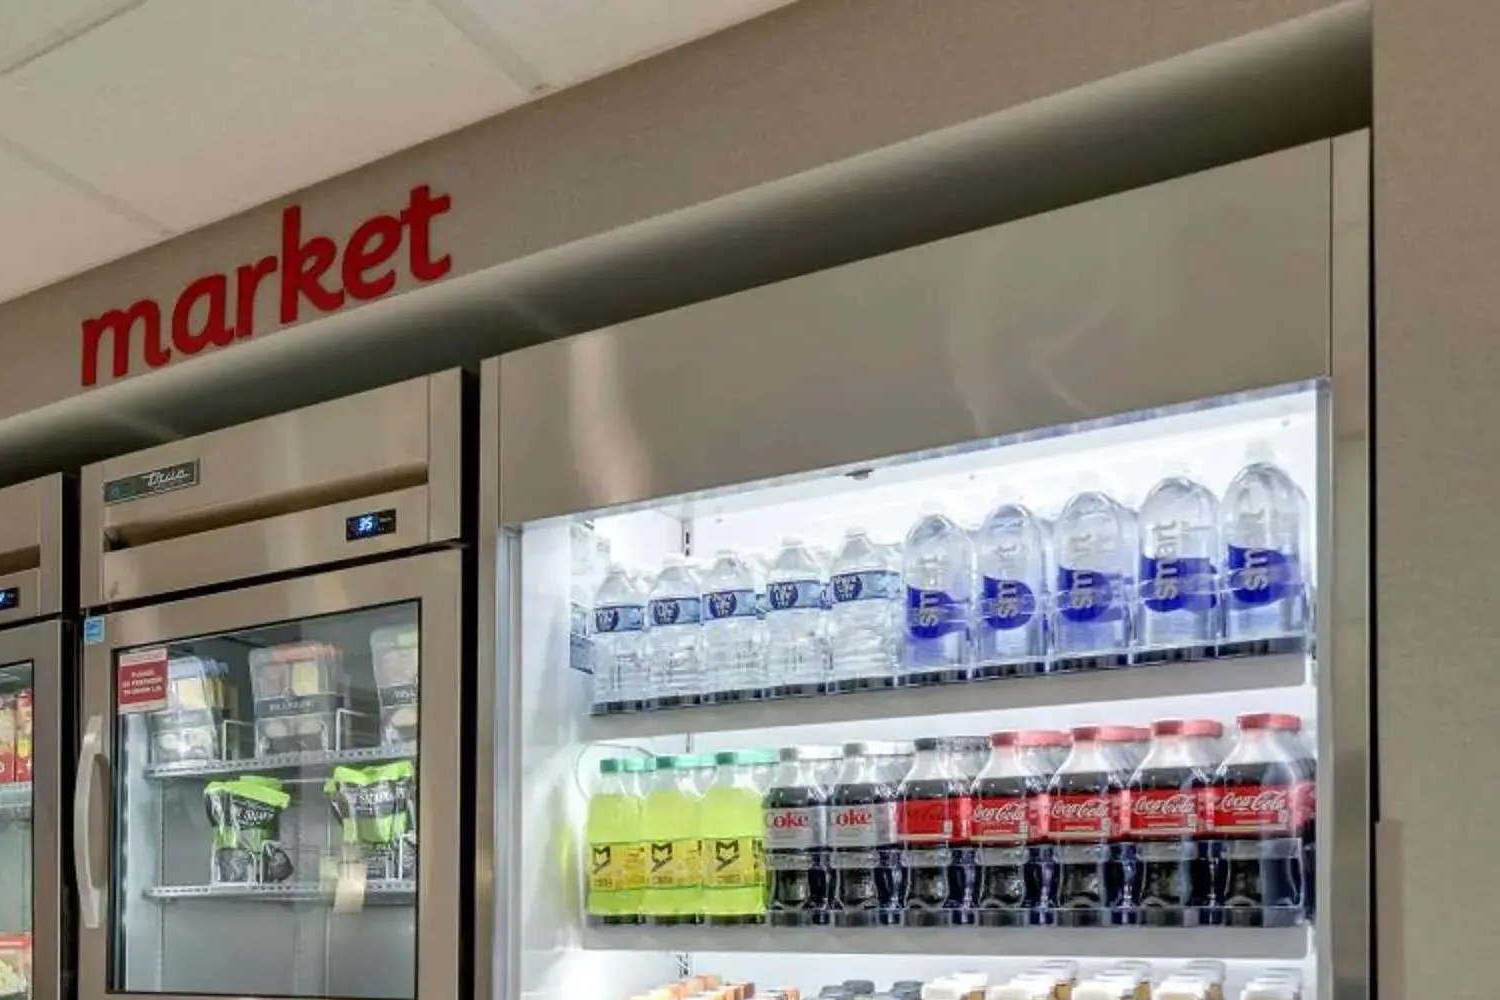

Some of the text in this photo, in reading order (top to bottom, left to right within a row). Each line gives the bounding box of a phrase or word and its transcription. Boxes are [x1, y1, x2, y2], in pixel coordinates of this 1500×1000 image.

[81, 183, 452, 387] market
[916, 553, 939, 628] smart
[996, 543, 1018, 619] smart
[1071, 532, 1094, 610] smart
[1152, 519, 1177, 601] smart
